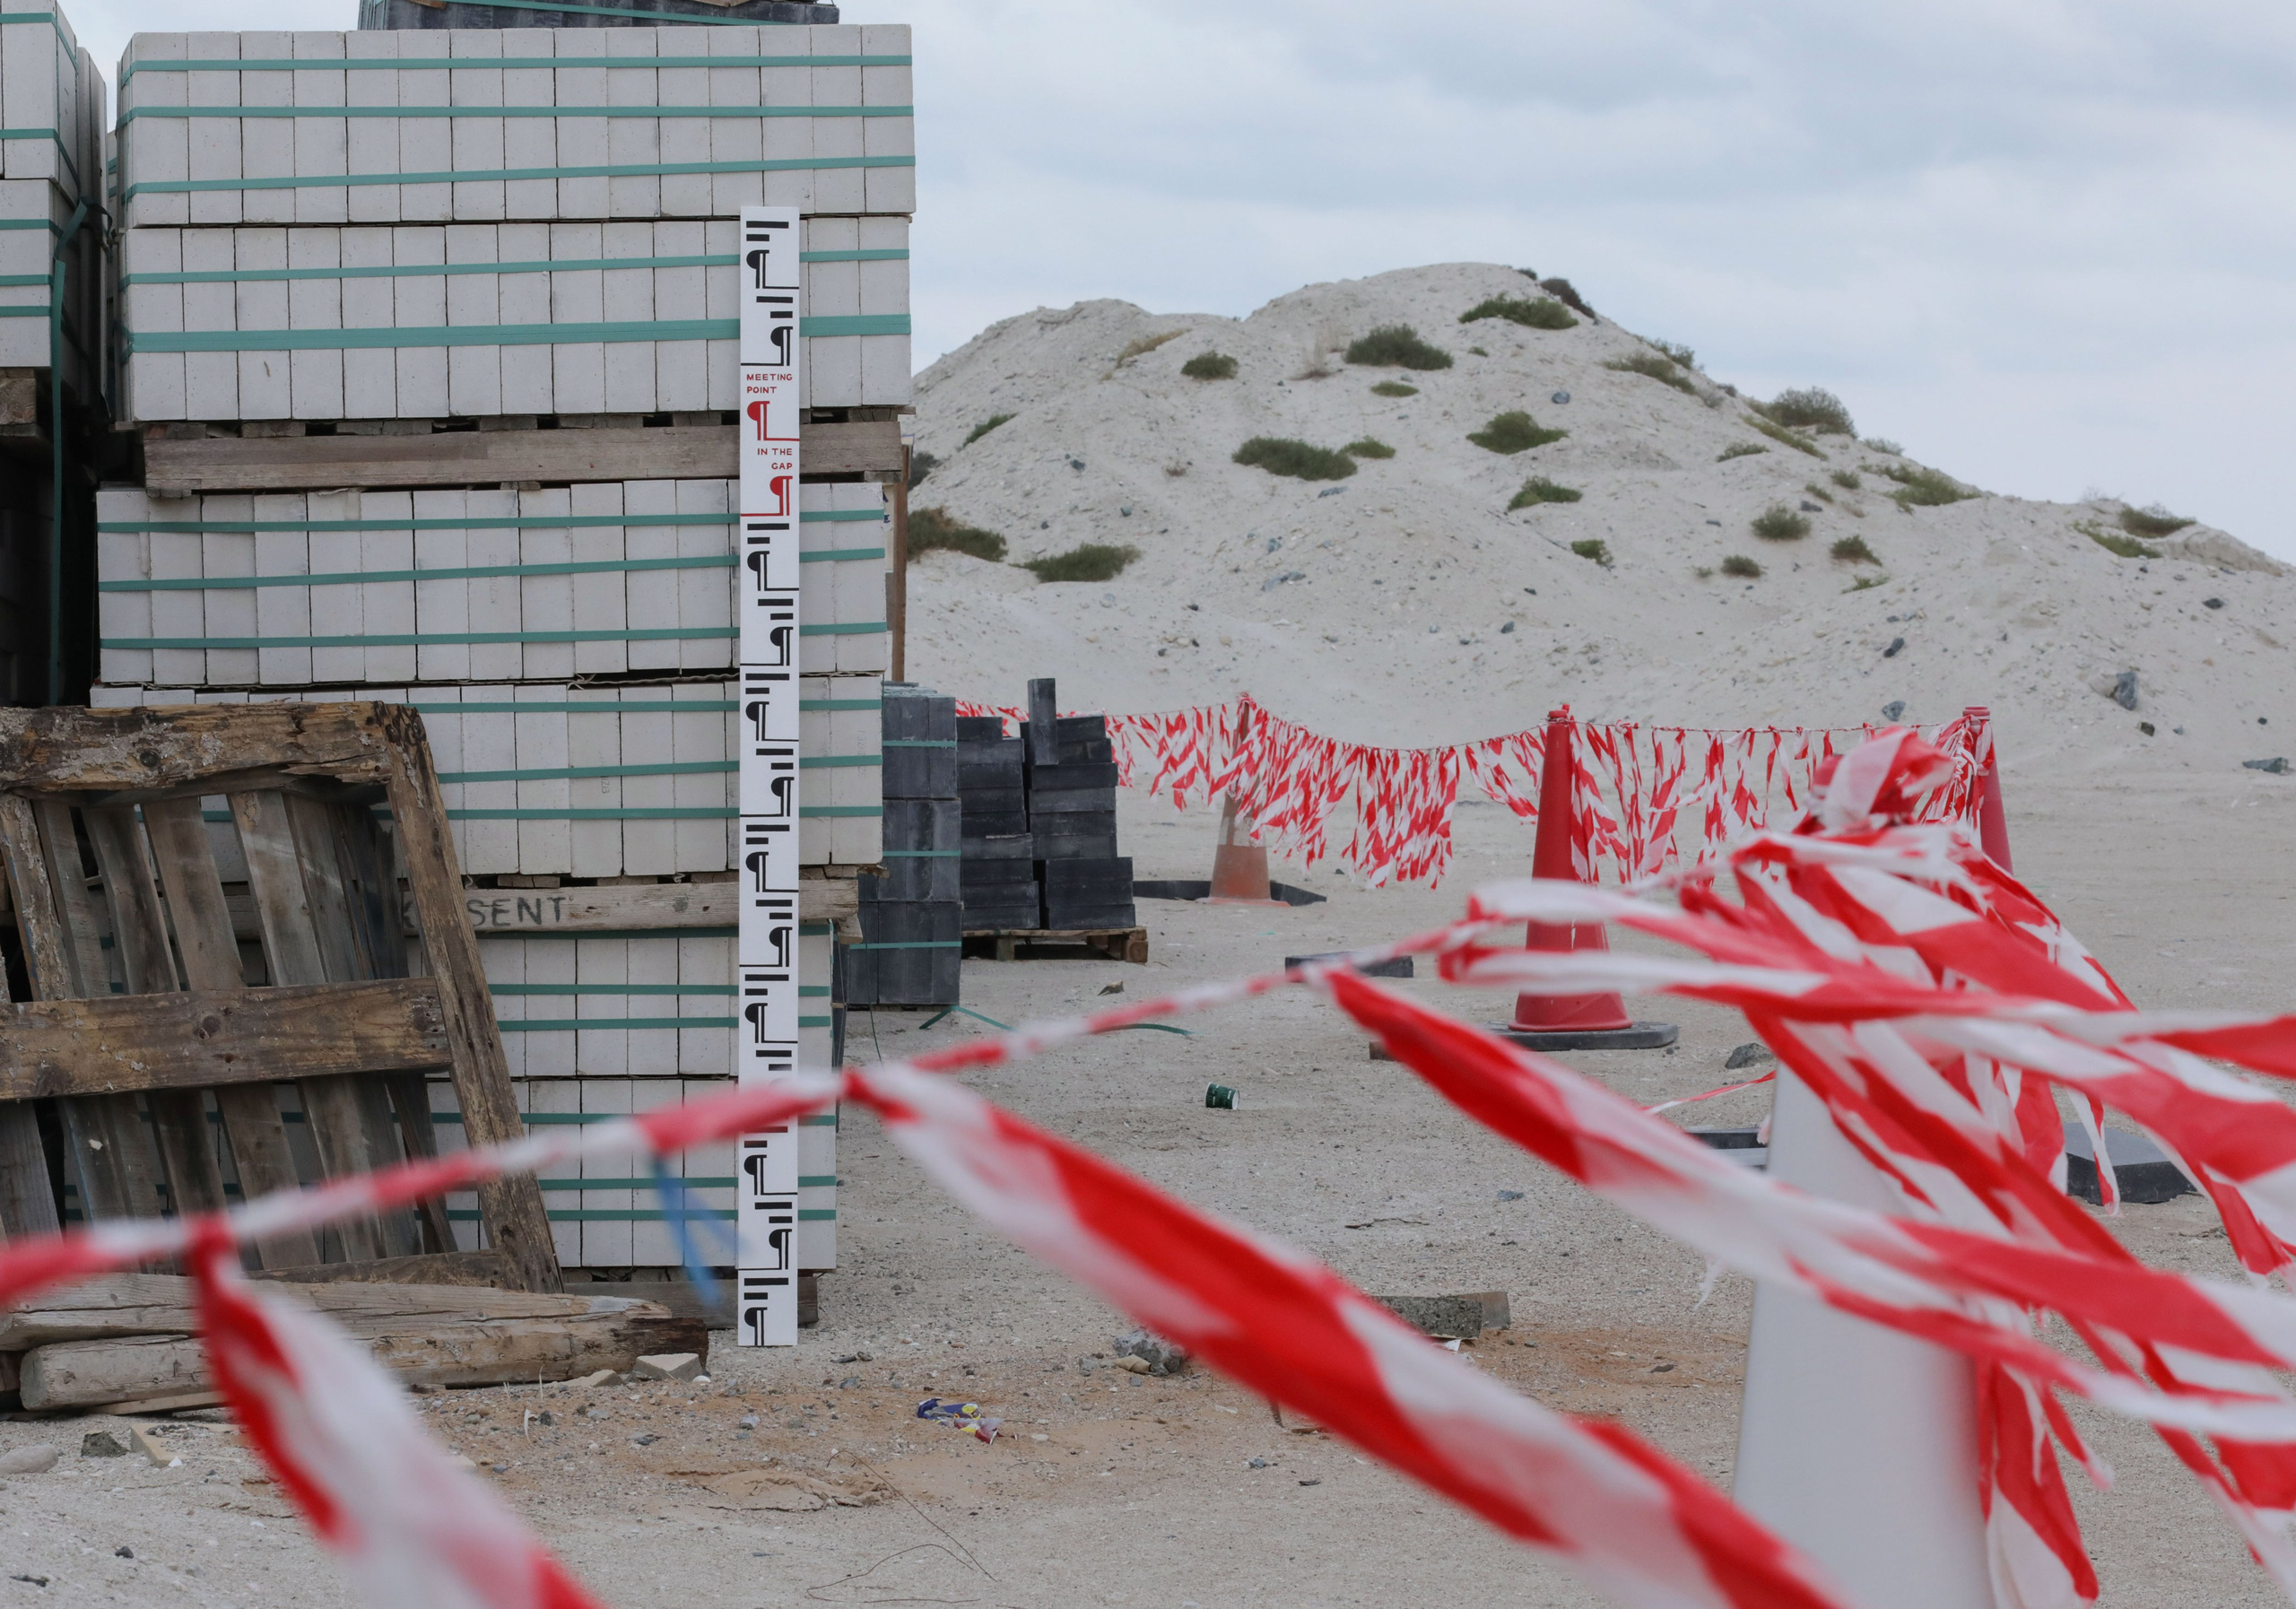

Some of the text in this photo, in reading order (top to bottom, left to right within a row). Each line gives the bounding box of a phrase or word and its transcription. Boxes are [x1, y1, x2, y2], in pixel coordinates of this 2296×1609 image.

[746, 373, 793, 381] MEETING
[746, 386, 778, 394] POINT
[757, 448, 793, 456] IN THE
[770, 462, 793, 470] GAP
